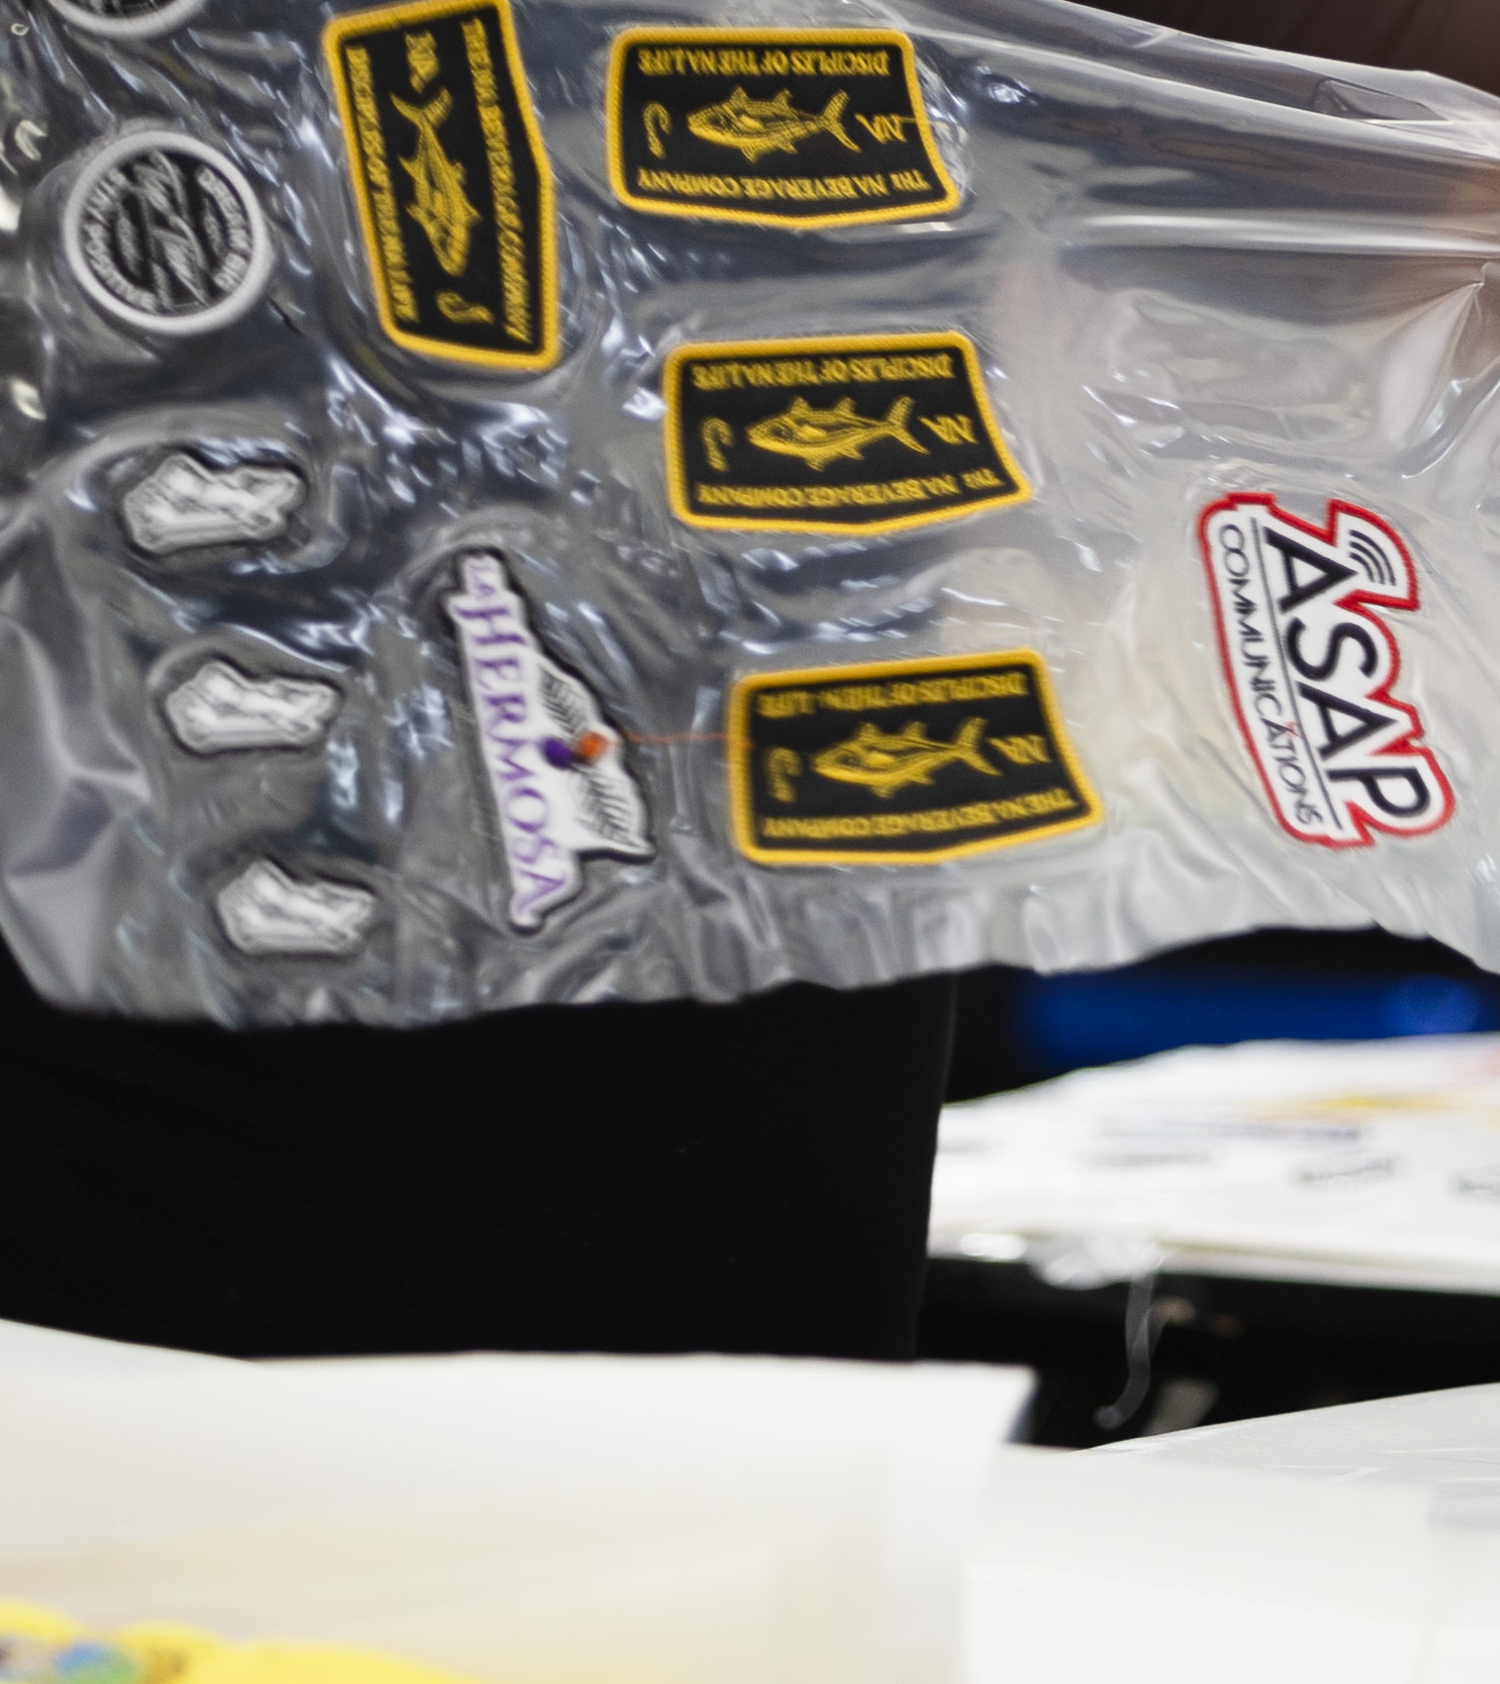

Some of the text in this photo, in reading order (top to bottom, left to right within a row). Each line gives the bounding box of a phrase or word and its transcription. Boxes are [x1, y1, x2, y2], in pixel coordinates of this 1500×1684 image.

[638, 48, 890, 76] DISCIPLES OF THE NA LIFE
[855, 113, 907, 144] NA
[479, 105, 521, 225] BEVERAGE
[344, 46, 390, 154] DISCIPLES
[385, 270, 420, 323] LIFE
[636, 167, 739, 198] COMPANY
[740, 175, 852, 201] BEVERAGE
[855, 174, 887, 196] NA
[197, 167, 252, 256] DREAM
[214, 252, 252, 295] BIG
[496, 227, 532, 344] COMPANY
[692, 353, 956, 391] DISCIPLES OF THE NA LIFE
[918, 415, 979, 445] NA
[696, 481, 806, 508] COMPANY
[805, 478, 929, 508] BEVERAGE
[929, 475, 961, 497] NA
[914, 671, 1028, 703] DISCIPLES
[1218, 522, 1324, 826] COMMUNICATIONS
[1260, 525, 1432, 818] ASAP
[756, 691, 816, 718] LIFE
[840, 685, 881, 710] THE
[889, 680, 916, 706] OF
[454, 602, 566, 914] HERMOSA
[986, 734, 1051, 766] NA
[762, 787, 1078, 839] THE NA BEVERAGE COMPANY
